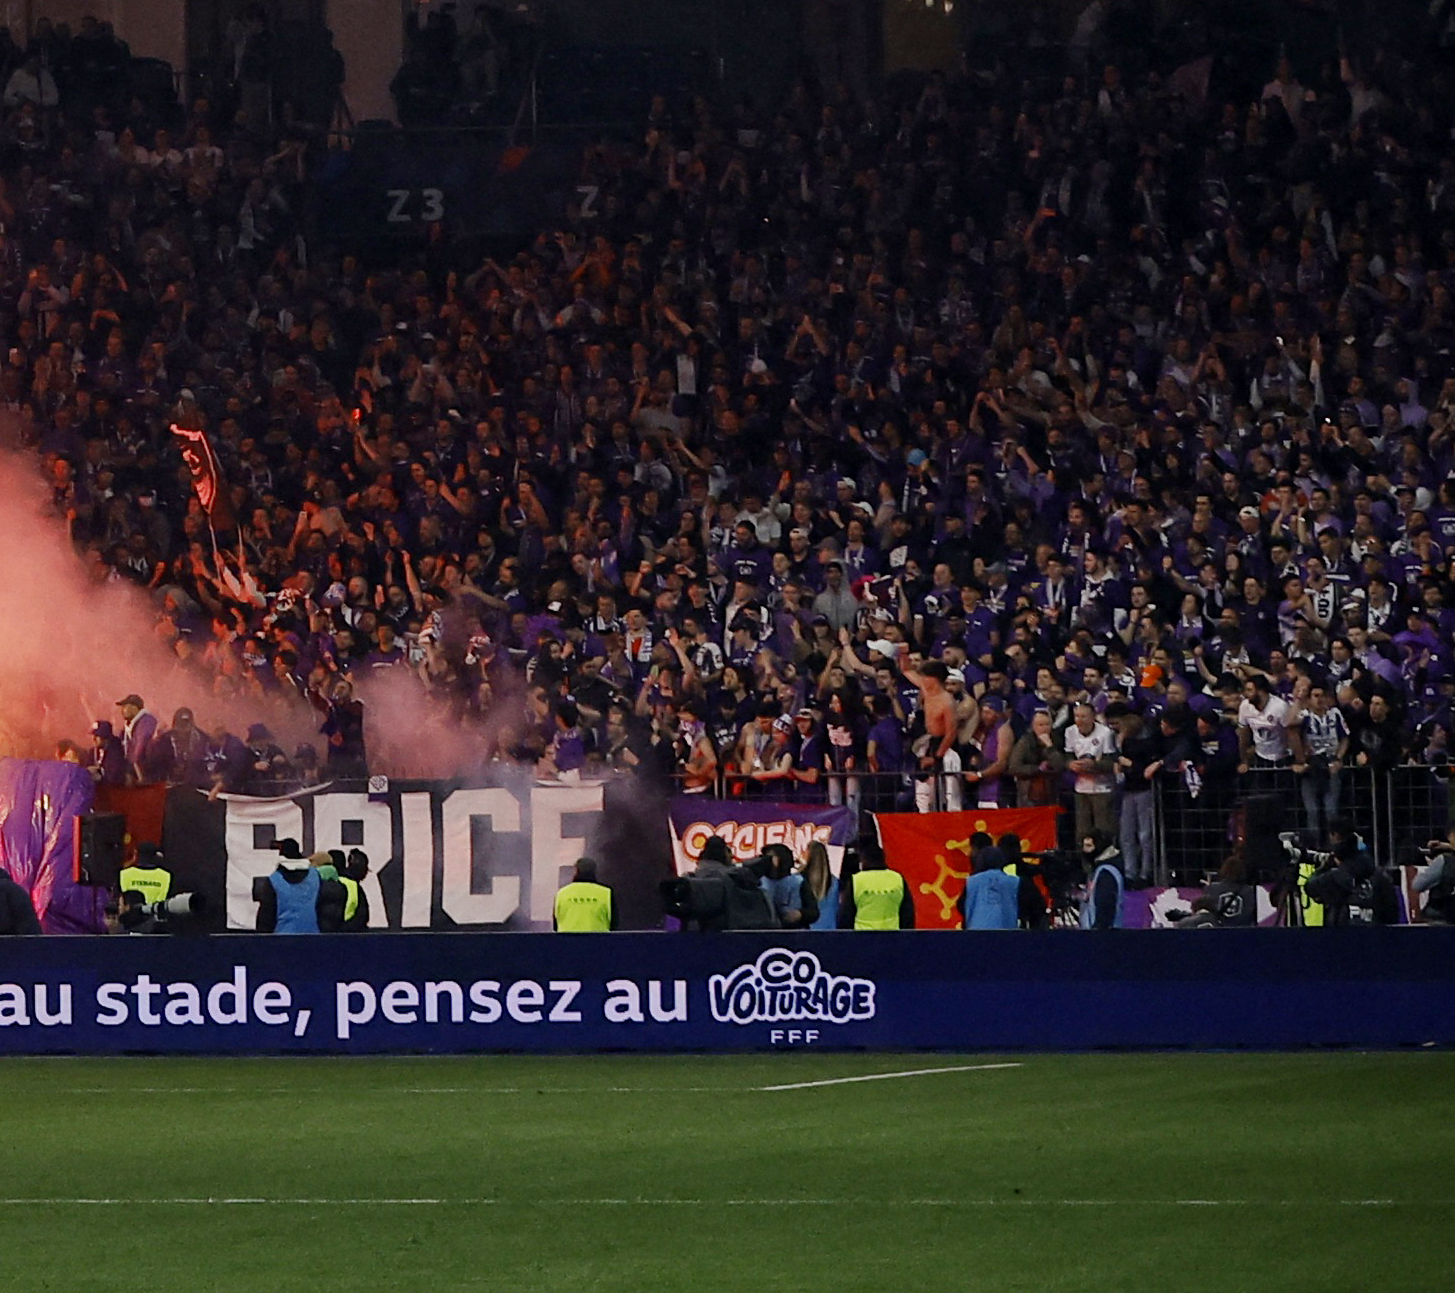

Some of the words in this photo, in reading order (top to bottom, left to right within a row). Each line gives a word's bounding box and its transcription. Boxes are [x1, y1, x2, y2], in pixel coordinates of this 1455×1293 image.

[759, 952, 816, 985] CO
[97, 967, 311, 1035] stade,
[337, 980, 582, 1039] pensez
[605, 979, 687, 1022] au
[770, 1029, 820, 1044] FFF
